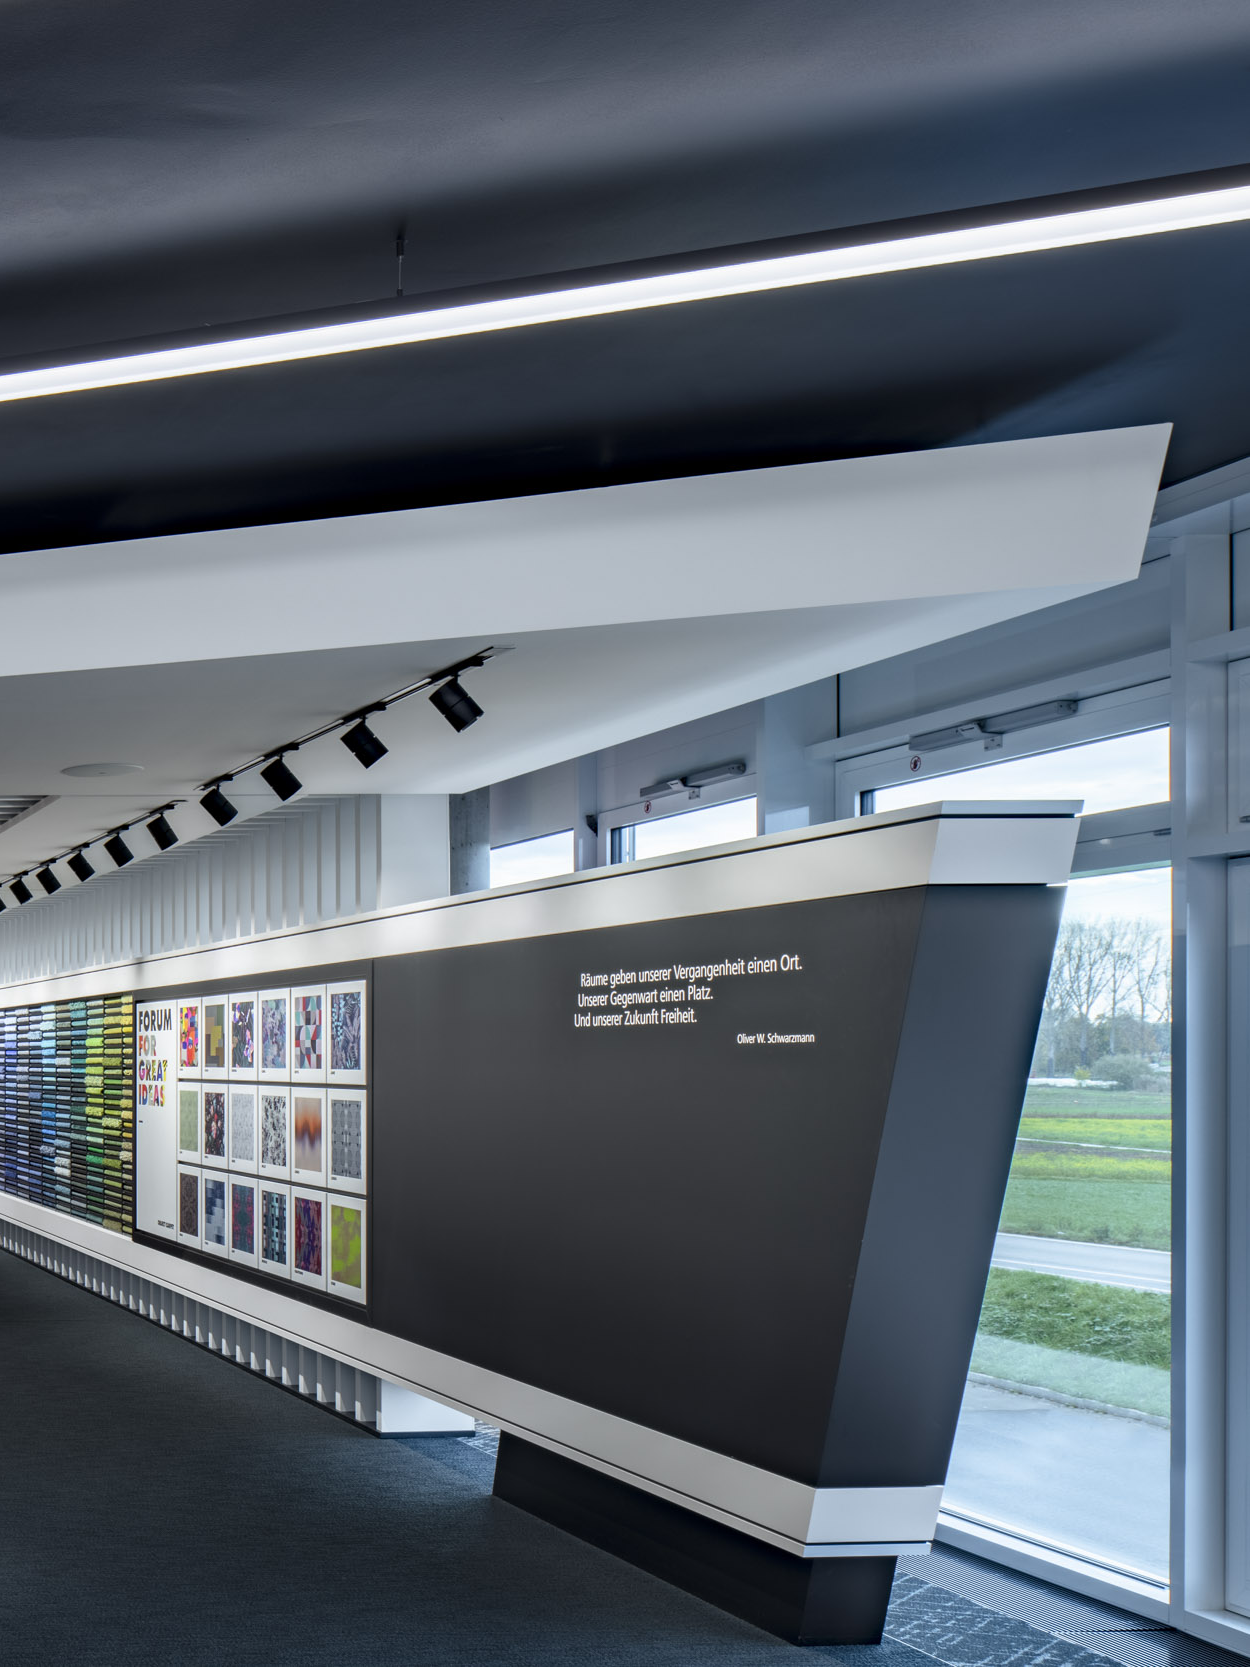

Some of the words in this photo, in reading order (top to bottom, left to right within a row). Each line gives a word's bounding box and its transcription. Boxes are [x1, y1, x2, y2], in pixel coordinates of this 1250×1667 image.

[580, 973, 609, 987] Räume
[610, 969, 637, 989] geben
[638, 968, 672, 983] unserer
[673, 958, 746, 983] Vergangenheit
[747, 956, 778, 974] einen
[780, 954, 803, 971] Ort.
[578, 994, 609, 1008] Unserer
[610, 988, 659, 1009] Gegenwart
[659, 987, 685, 1003] einen
[687, 984, 714, 1001] Platz.
[138, 1008, 172, 1032] FORUM
[574, 1012, 591, 1028] Und
[592, 1014, 623, 1027] unserer
[624, 1008, 659, 1025] Zukunft
[660, 1007, 698, 1024] Freiheit.
[138, 1035, 157, 1056] FOR
[737, 1033, 756, 1044] Oliver
[756, 1033, 766, 1044] W.
[767, 1032, 815, 1044] Schwarzmann
[138, 1059, 168, 1082] GREAT
[138, 1084, 165, 1107] IDEAS
